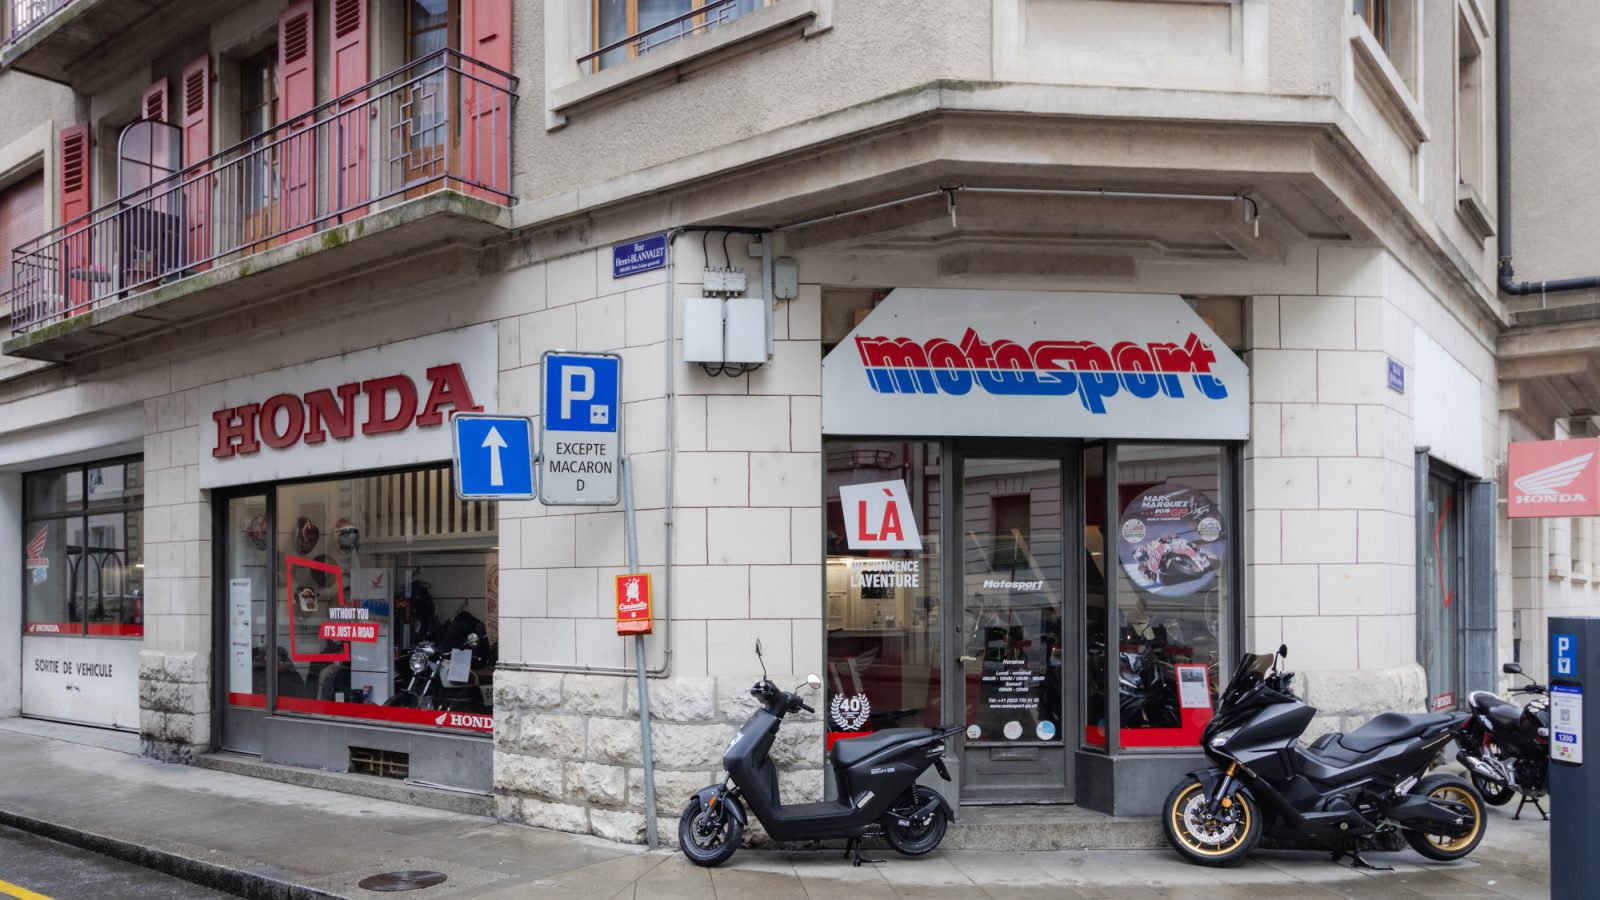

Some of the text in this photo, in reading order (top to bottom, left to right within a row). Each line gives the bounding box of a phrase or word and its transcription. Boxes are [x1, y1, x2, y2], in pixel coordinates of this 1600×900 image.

[634, 243, 645, 252] Rue
[855, 327, 1228, 414] motosport
[561, 365, 595, 419] P
[212, 363, 484, 458] HONDA
[556, 443, 606, 456] EXCEPTE
[550, 461, 612, 474] MACARON
[576, 479, 585, 491] D
[1515, 493, 1586, 504] HONDA
[858, 488, 904, 541] LÀ
[850, 574, 919, 588] LAVENTURE
[983, 580, 1043, 590] Motosport
[329, 607, 369, 620] WITHOUT YOU
[324, 625, 374, 638] IT'S JUST A ROAD
[1558, 637, 1569, 657] P
[35, 659, 112, 678] SORTIE DE VEHICULE
[840, 698, 860, 711] 40
